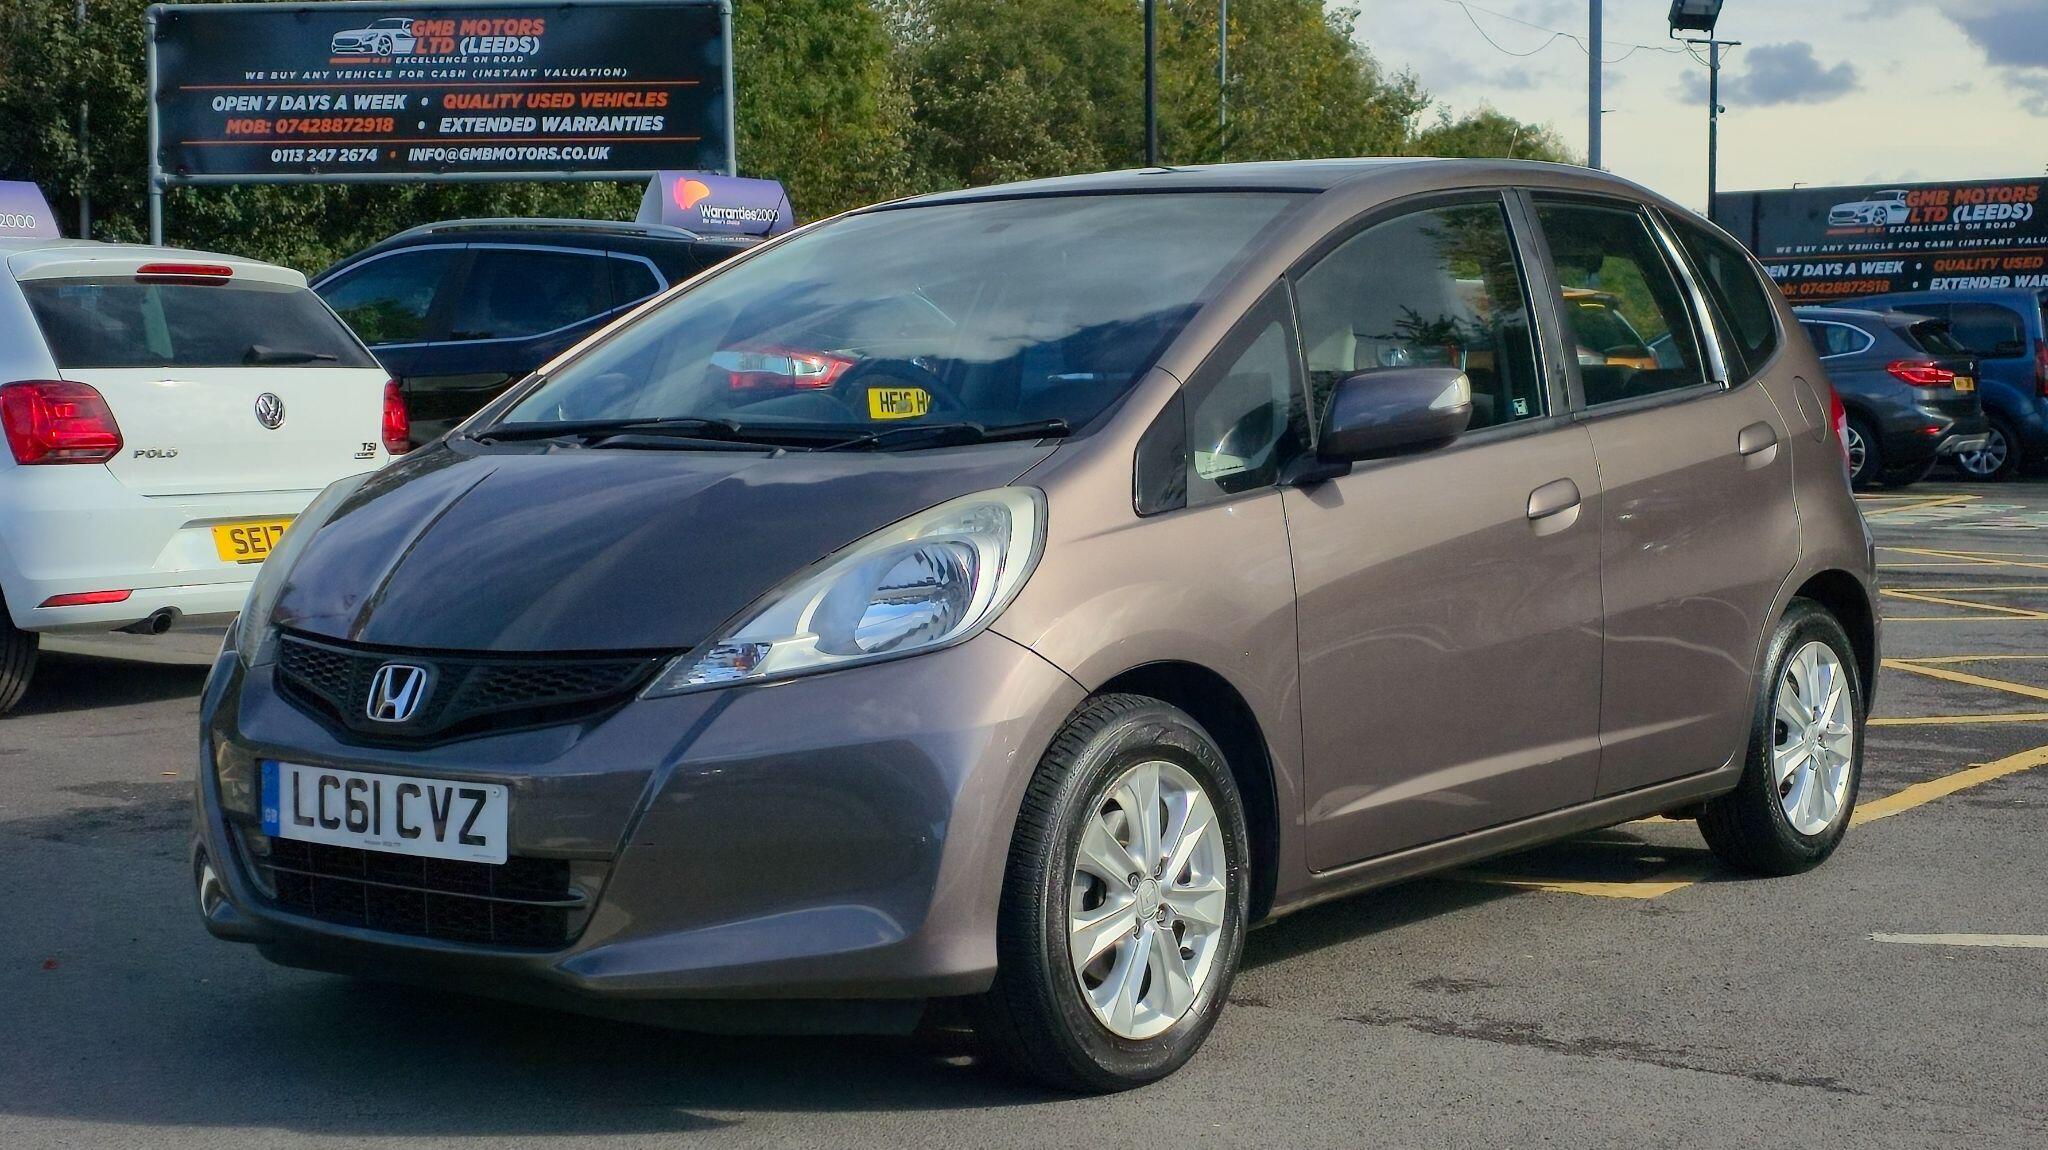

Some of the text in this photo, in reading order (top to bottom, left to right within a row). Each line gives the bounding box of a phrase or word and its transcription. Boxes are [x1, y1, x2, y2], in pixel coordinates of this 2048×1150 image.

[411, 18, 545, 37] GMB MOTORS
[416, 36, 540, 55] LTD (LEEDS)
[395, 56, 468, 64] EXCELLENCE
[493, 55, 524, 63] ROAD
[245, 67, 628, 79] WE BUY ANY VEHICLE FOR CASH (INSTANT VALUATION)
[211, 92, 669, 112] OPEN 7 DAYS A WEEK QUALITY USED VEHICLES
[226, 115, 665, 135] MOB: 07428872918 EXTENDED WARRANTIES
[271, 147, 610, 163] 0113 247 2674 INFO@GMBMOTORS.CO.UK
[1908, 186, 2039, 206] GMB MOTORS
[700, 204, 780, 222] Warranties2000
[1910, 202, 2033, 223] LTD (LEEDS)
[1889, 221, 2016, 233] EXCELLENCE ON ROAD
[1776, 236, 2048, 254] WE BUY ANY VEHICLE FOR CASH (INSTANT VALU
[1791, 264, 1802, 277] 7
[1803, 262, 1843, 277] DAYS
[1845, 262, 1857, 275] A
[1861, 260, 1905, 275] WEEK
[1934, 258, 2000, 271] QUALITY
[2002, 256, 2044, 270] USED
[1800, 279, 1890, 295] 07428872918
[1930, 276, 2010, 290] EXTENDED
[133, 449, 178, 459] POLO
[293, 771, 487, 847] LC61 CVZ
